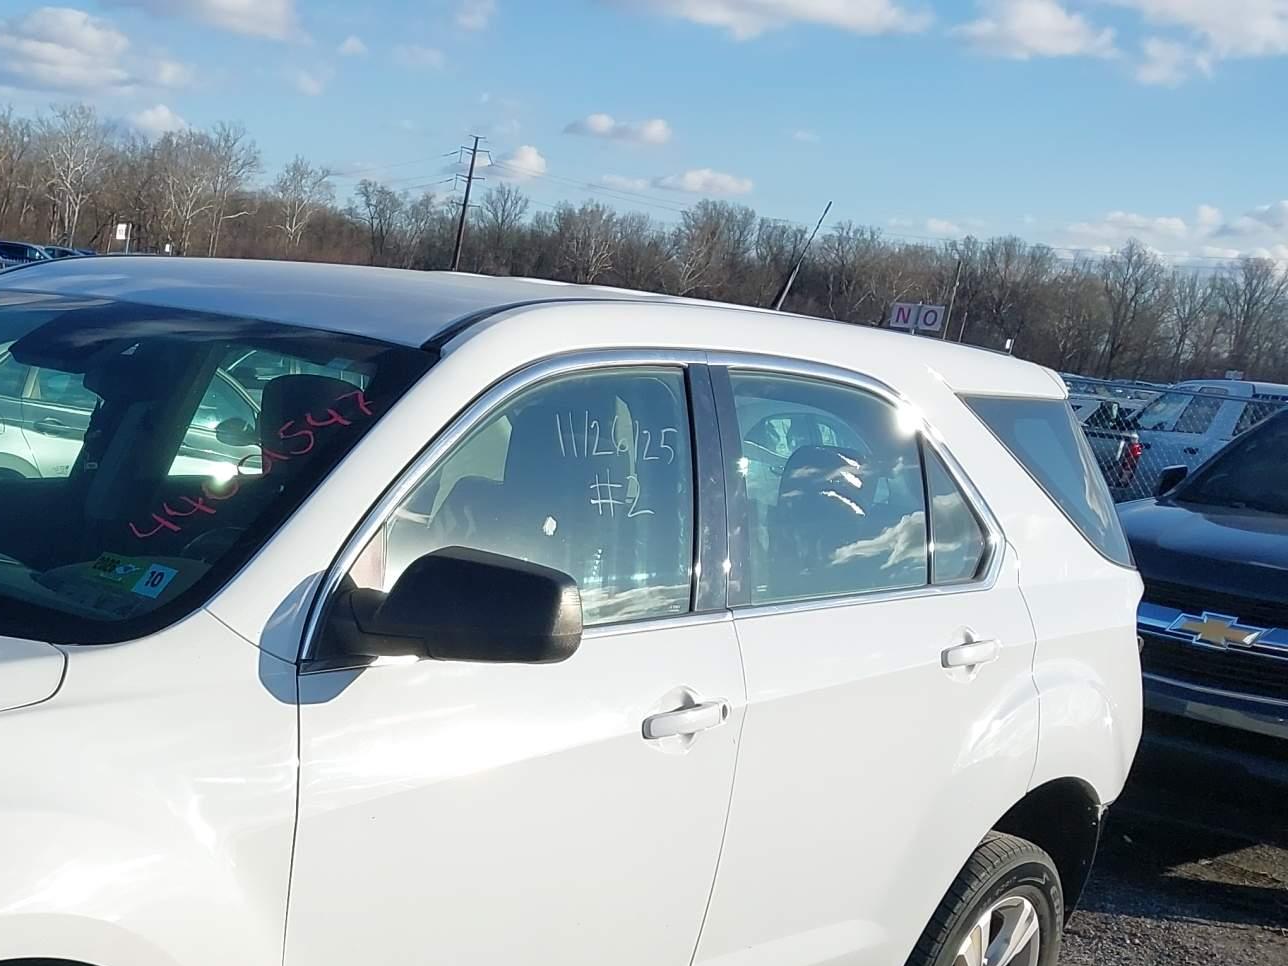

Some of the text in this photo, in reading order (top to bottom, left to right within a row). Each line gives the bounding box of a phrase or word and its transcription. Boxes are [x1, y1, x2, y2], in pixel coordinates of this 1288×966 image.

[556, 410, 678, 464] 11/26/25
[128, 389, 375, 539] 44001547
[589, 467, 655, 518] #2
[144, 570, 165, 587] 10
